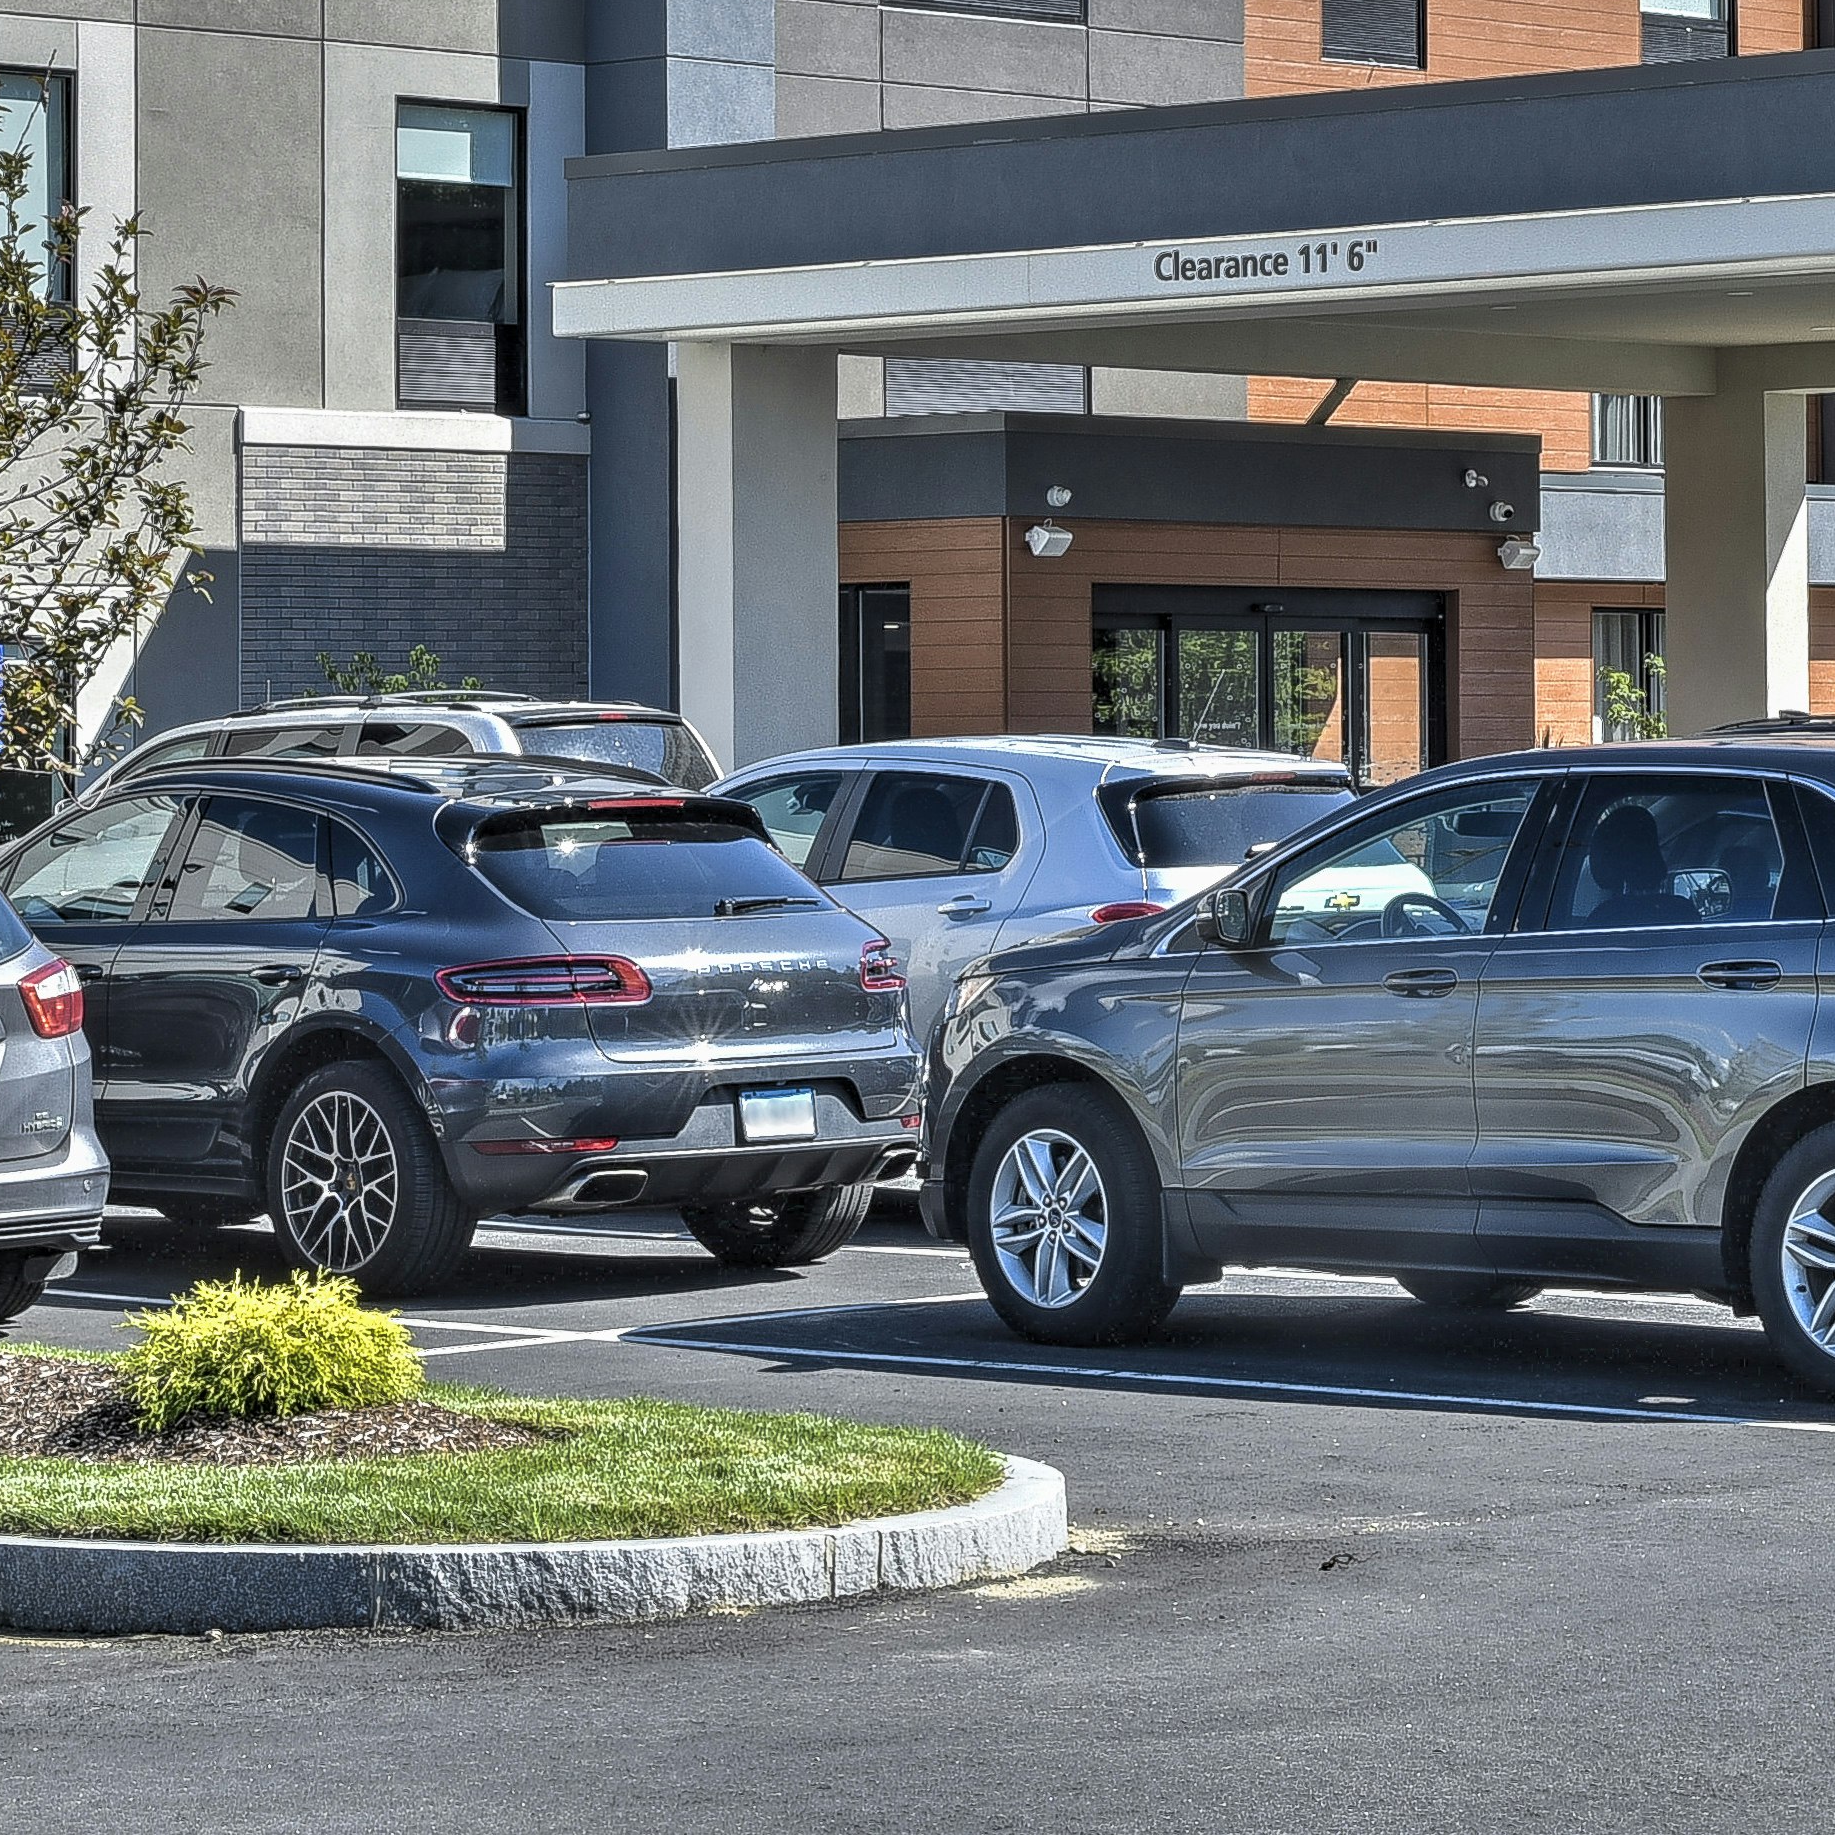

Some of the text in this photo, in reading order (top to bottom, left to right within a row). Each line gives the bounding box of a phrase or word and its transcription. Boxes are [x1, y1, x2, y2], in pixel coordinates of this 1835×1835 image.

[1154, 239, 1378, 282] Clearance 11' 6"
[697, 959, 828, 975] PORSCHE
